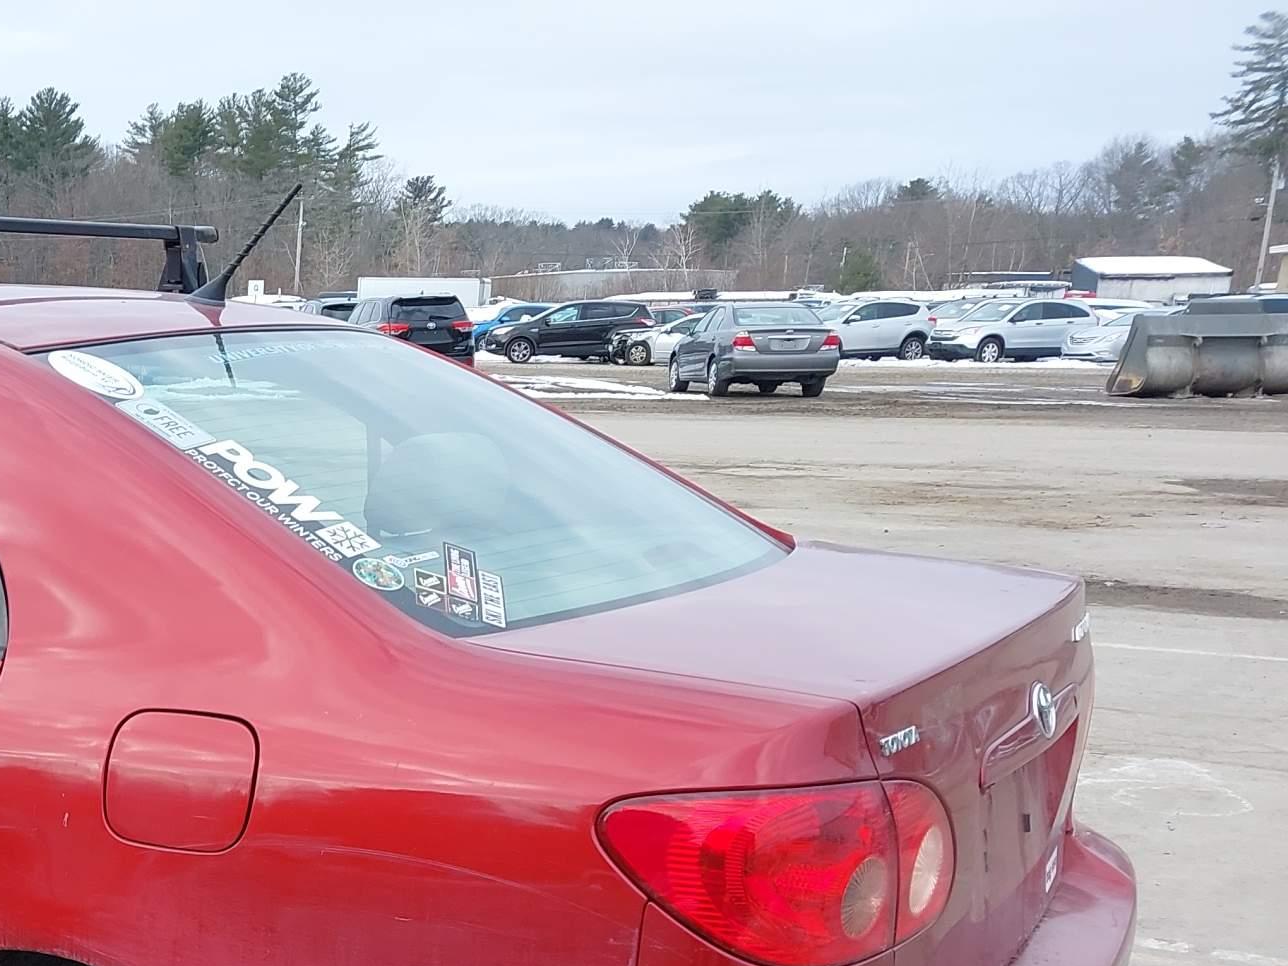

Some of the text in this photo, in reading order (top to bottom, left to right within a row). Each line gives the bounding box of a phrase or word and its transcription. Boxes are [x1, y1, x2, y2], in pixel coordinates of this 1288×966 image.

[153, 415, 195, 440] FREE
[197, 439, 345, 522] POW
[246, 490, 280, 516] OUR
[277, 513, 343, 562] WINTERS
[880, 725, 920, 757] TOYOTA
